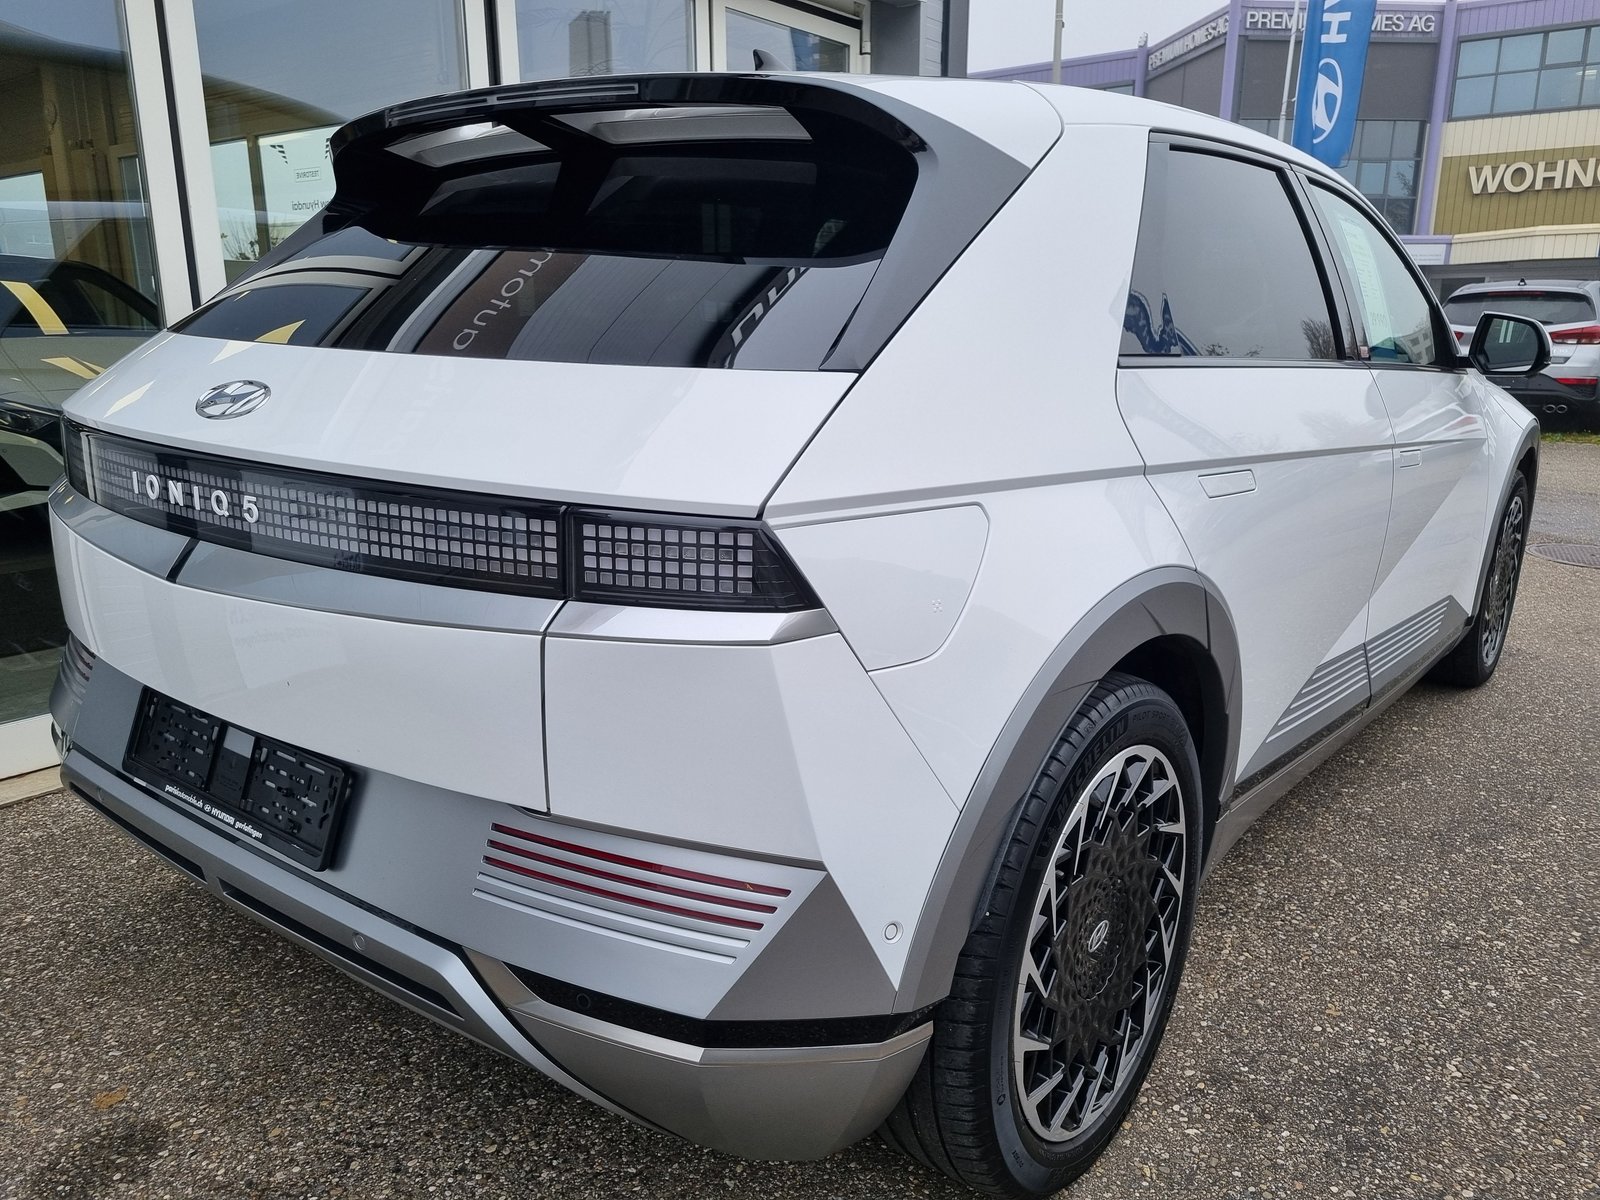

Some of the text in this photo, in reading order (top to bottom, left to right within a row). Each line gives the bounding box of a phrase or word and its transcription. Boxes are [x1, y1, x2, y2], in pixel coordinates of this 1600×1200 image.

[1246, 11, 1306, 29] PREMI
[1407, 15, 1435, 32] AG
[1469, 157, 1600, 195] WOHN
[132, 471, 259, 523] IONIQ 5
[1056, 717, 1127, 820] MICHELIN
[211, 807, 235, 825] HYUNDAI
